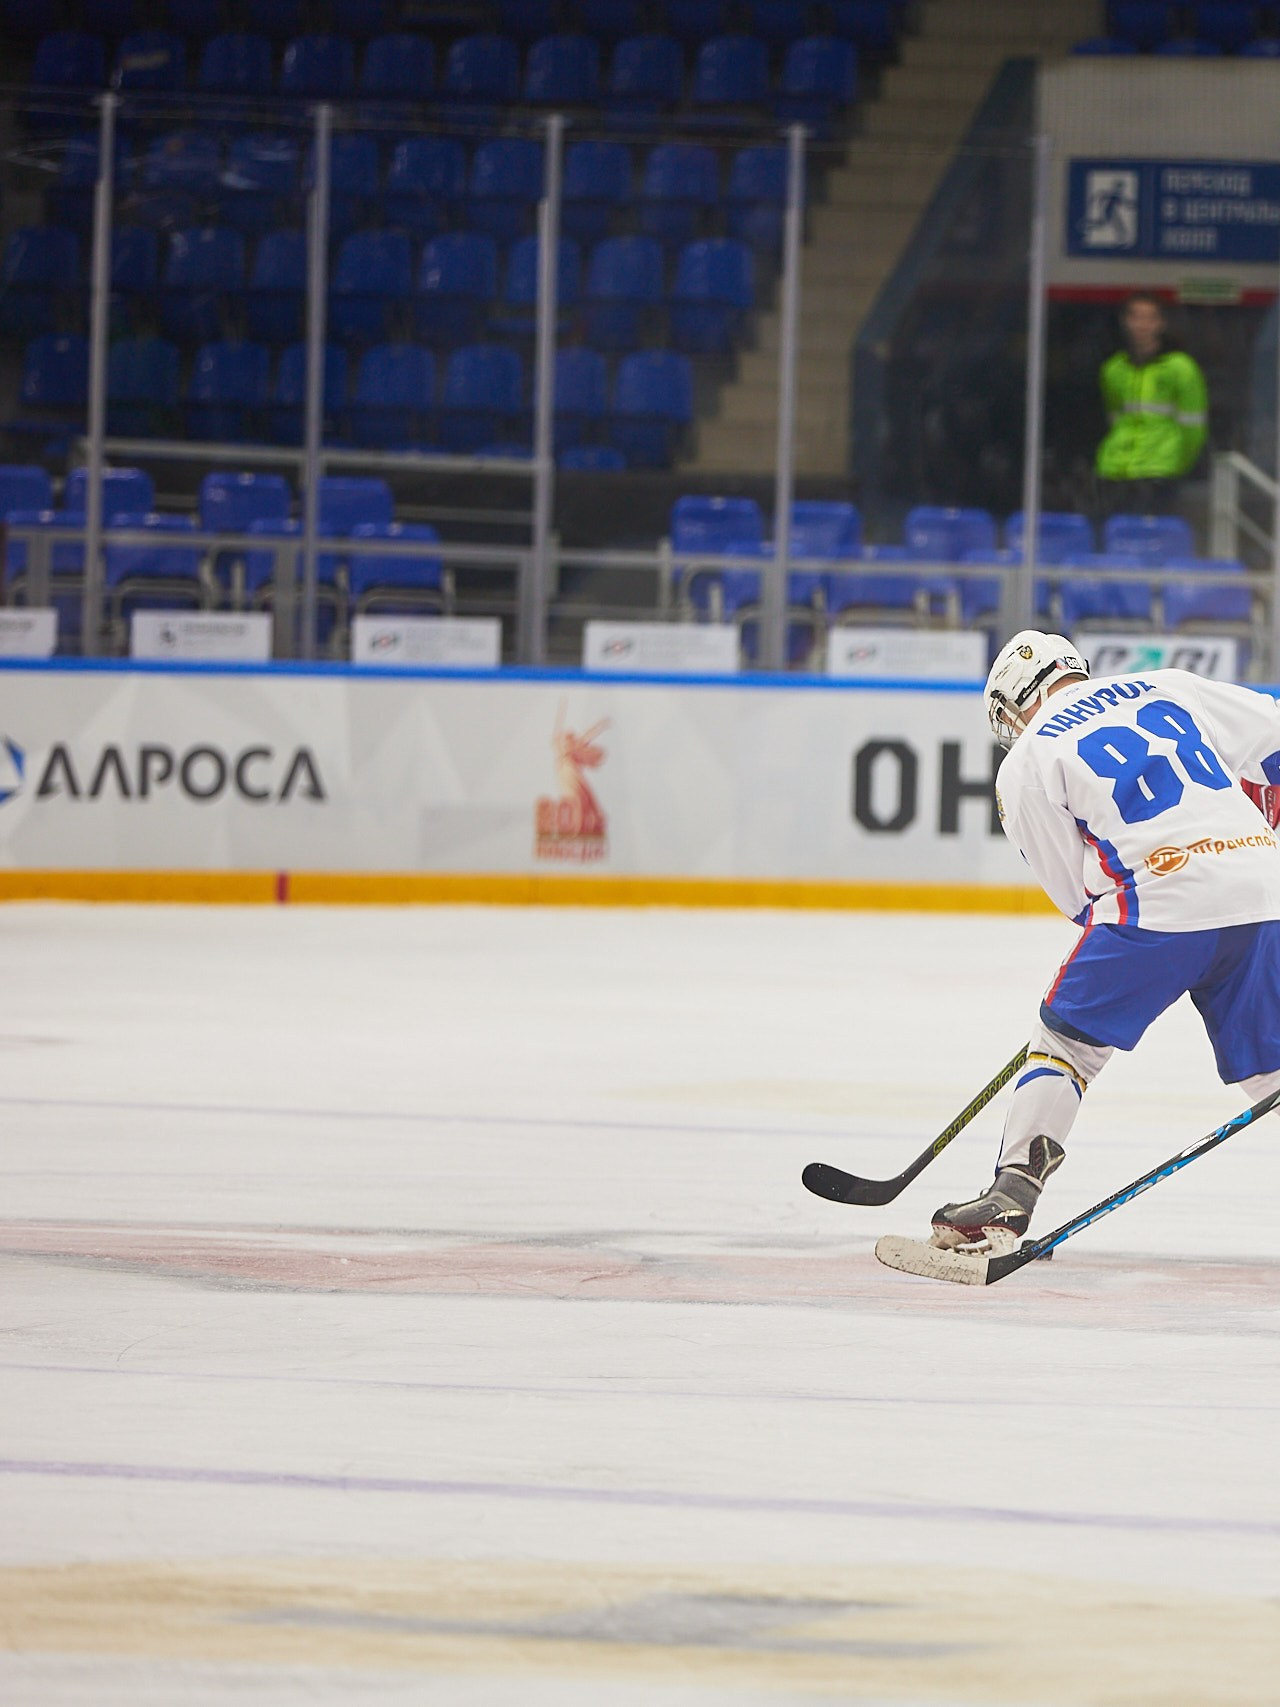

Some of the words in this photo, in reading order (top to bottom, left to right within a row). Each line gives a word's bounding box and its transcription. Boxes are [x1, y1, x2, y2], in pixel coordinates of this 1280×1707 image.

[36, 744, 327, 801] АЛРОСА
[1077, 700, 1233, 824] 88
[933, 1050, 1027, 1157] SHERWOO
